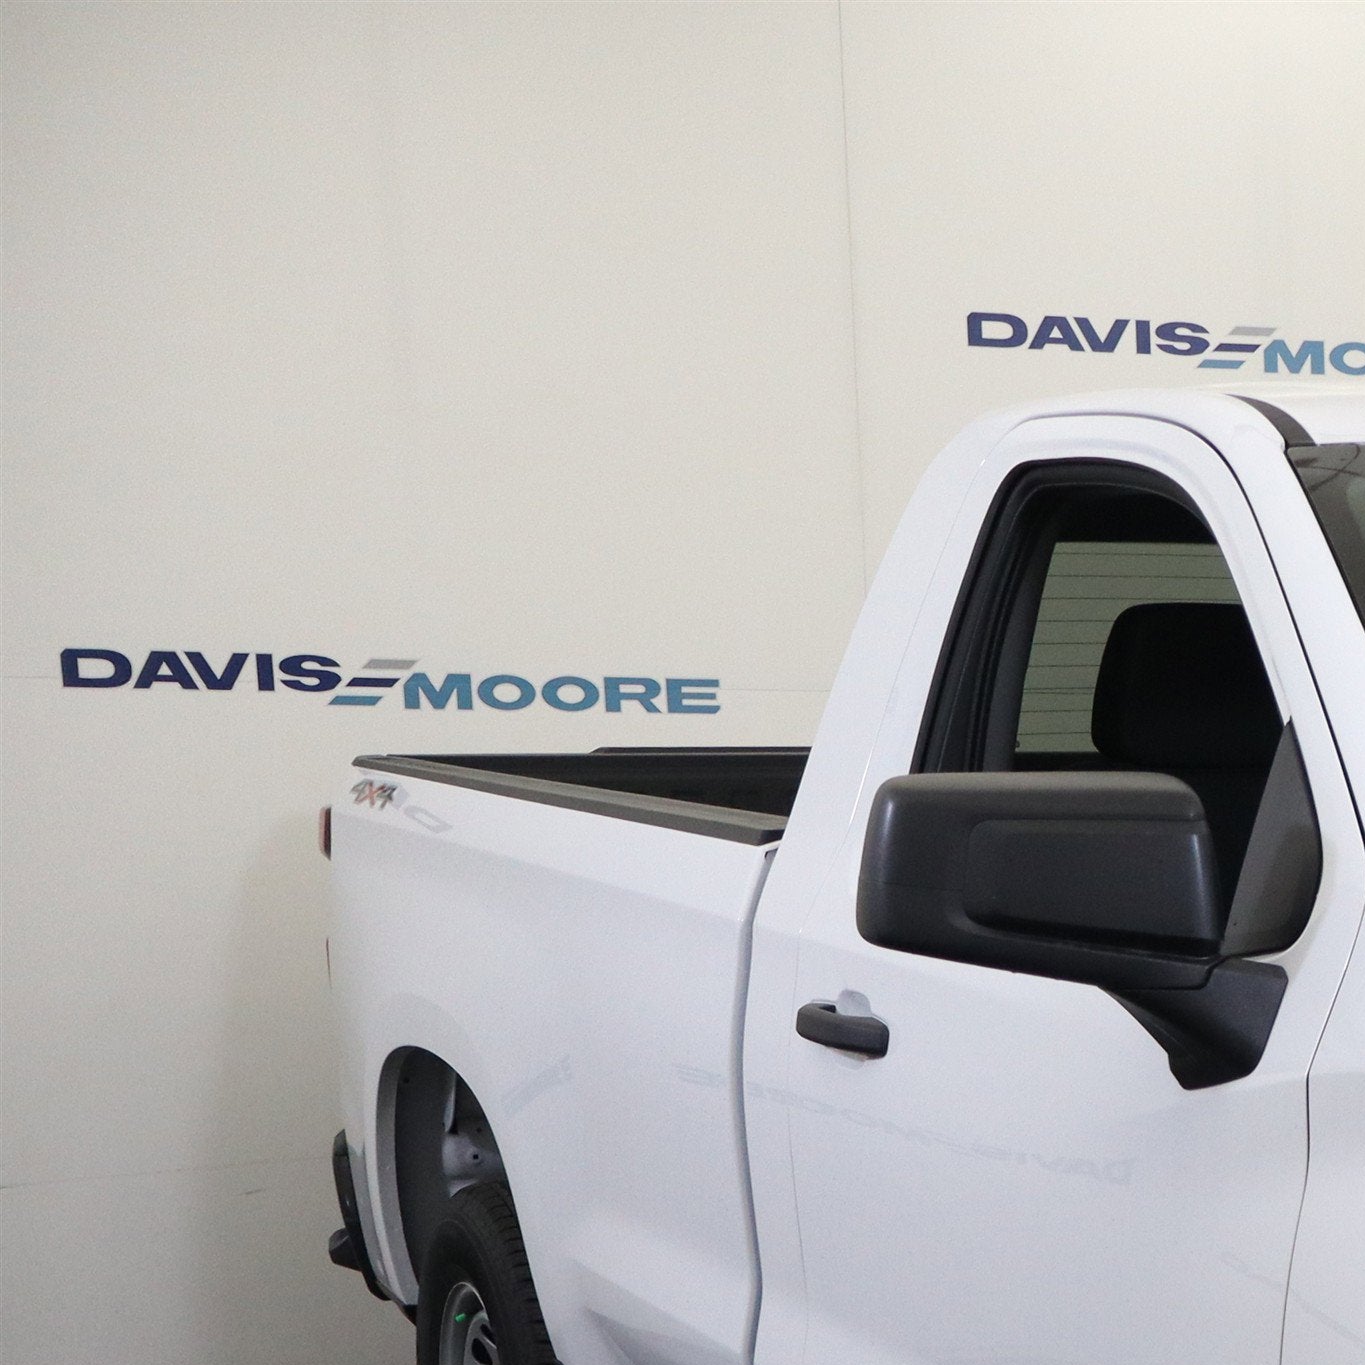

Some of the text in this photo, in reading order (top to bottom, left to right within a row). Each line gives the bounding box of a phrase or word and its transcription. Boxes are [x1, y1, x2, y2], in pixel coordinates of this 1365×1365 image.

[966, 311, 1210, 355] DAVIS
[60, 647, 721, 714] DAVIS MOORE
